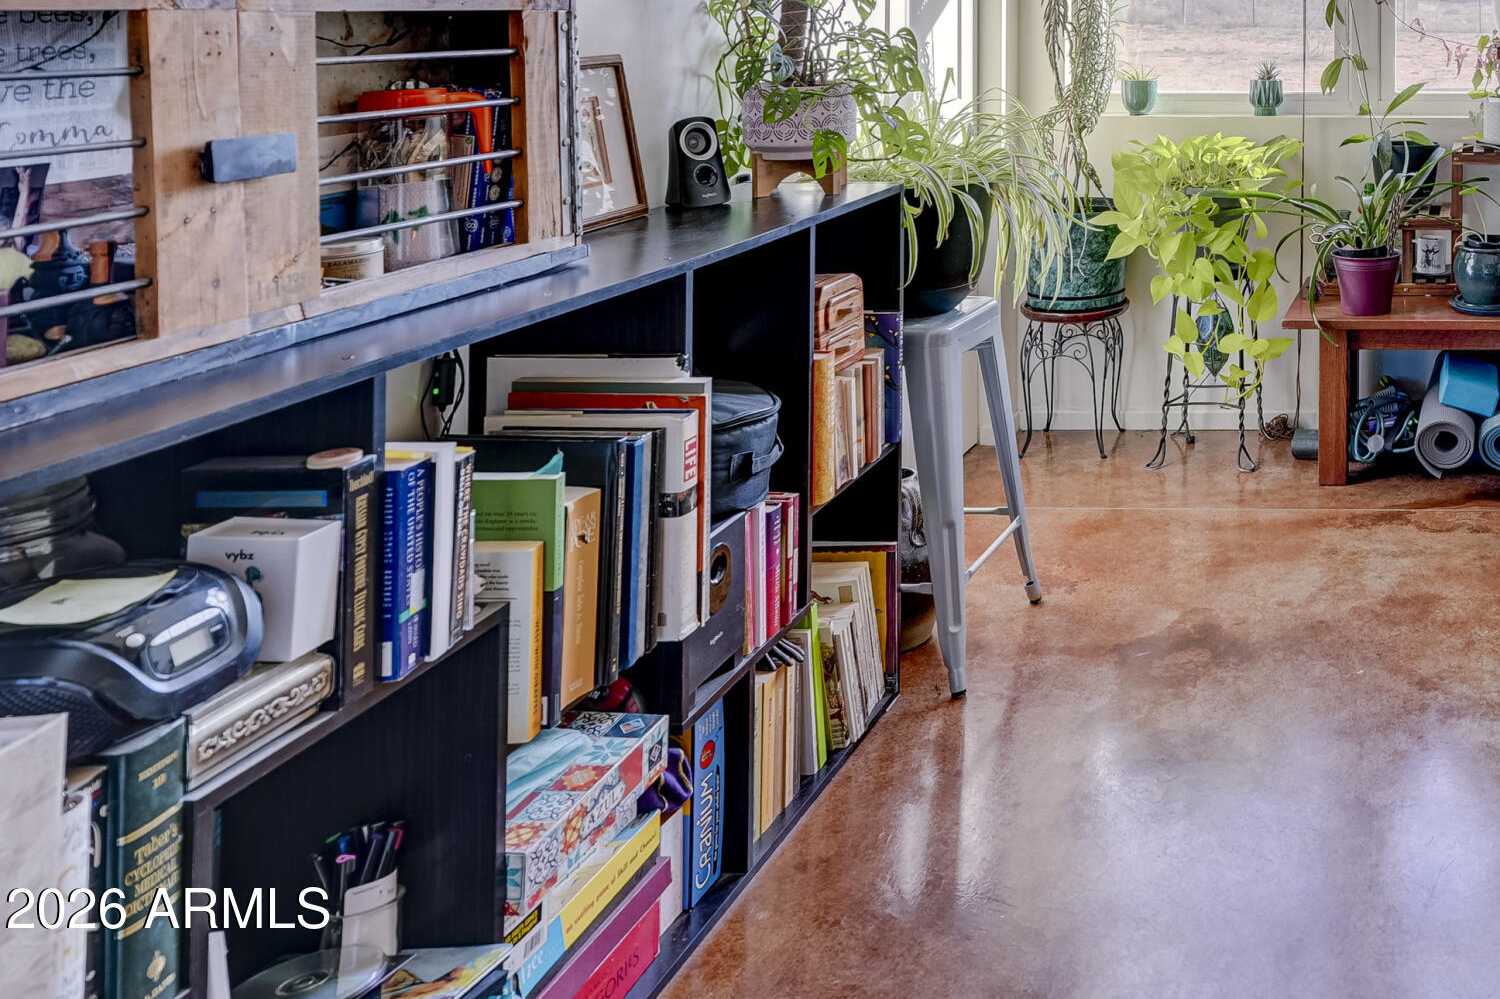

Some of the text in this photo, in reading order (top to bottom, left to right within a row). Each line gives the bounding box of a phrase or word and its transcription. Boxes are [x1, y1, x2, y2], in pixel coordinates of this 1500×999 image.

[15, 42, 96, 64] trees,
[43, 78, 96, 101] the
[684, 436, 698, 482] LIFE
[407, 472, 416, 488] OF
[463, 462, 474, 500] WHERE
[406, 491, 416, 514] THE
[461, 503, 470, 526] THE
[413, 468, 426, 572] A PEOPLE'S HISTO
[405, 516, 416, 563] UNITED
[225, 550, 254, 563] vybz
[457, 529, 468, 590] CRAWDADS
[134, 822, 180, 865] Taber's
[695, 770, 714, 890] CRANIUM
[573, 900, 595, 926] exciting
